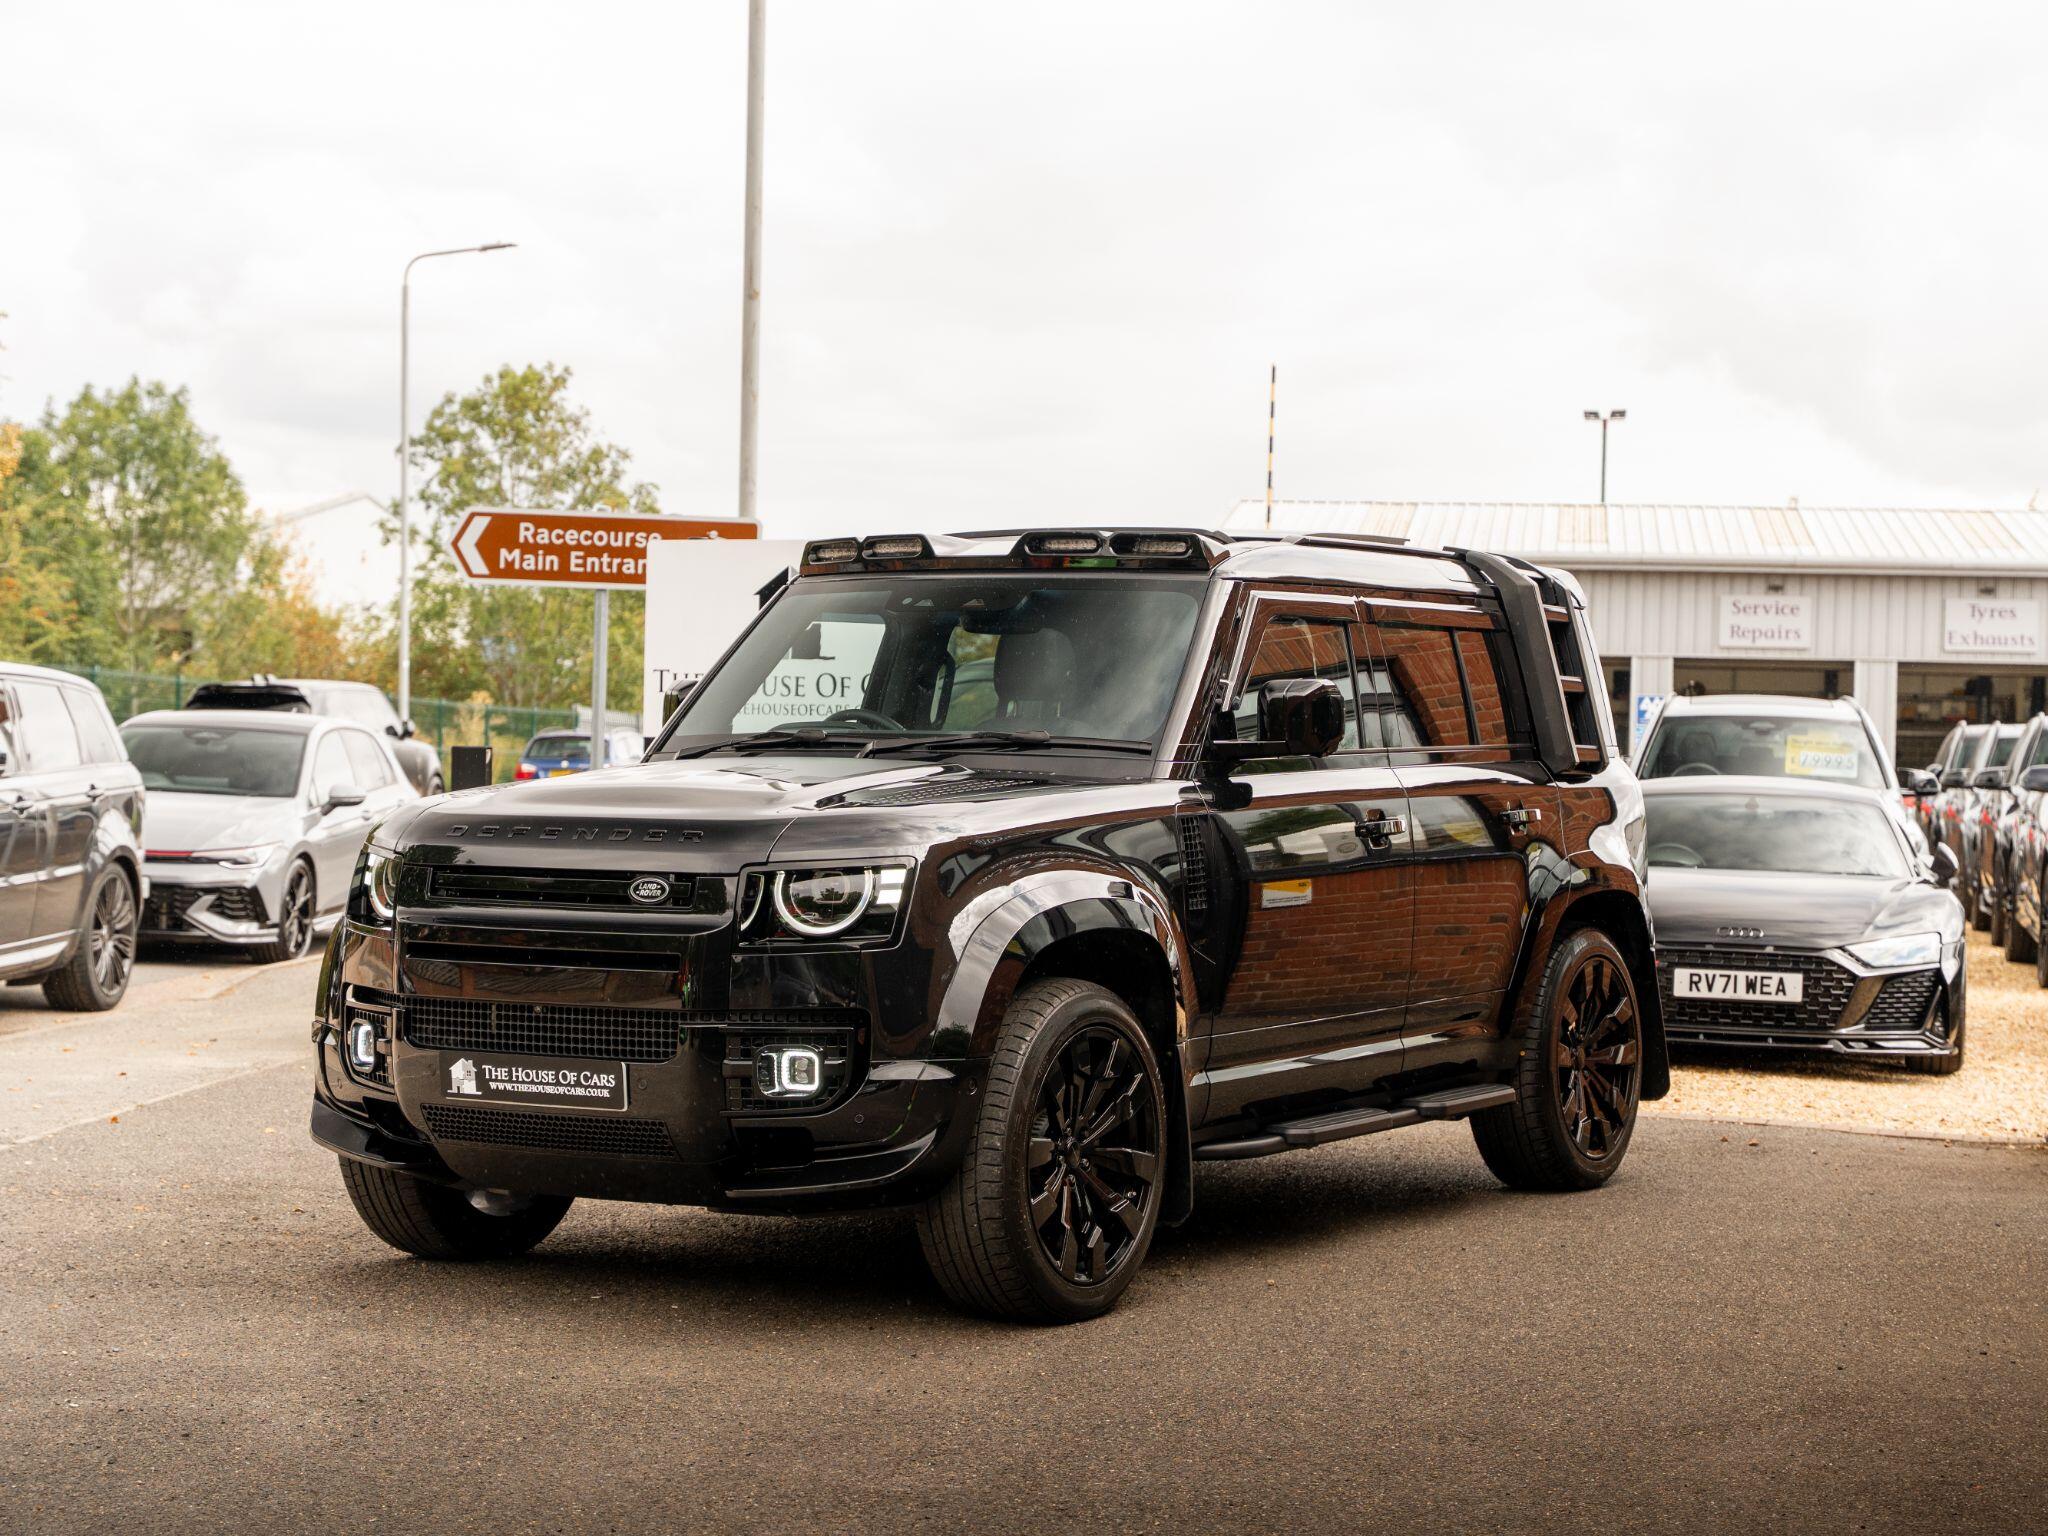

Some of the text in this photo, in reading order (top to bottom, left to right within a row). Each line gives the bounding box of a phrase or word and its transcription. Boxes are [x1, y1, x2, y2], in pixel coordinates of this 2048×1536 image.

[499, 547, 647, 575] Main Entran
[1731, 600, 1801, 617] Service
[1968, 603, 2018, 622] Tyres
[1729, 624, 1802, 644] Repairs
[1947, 629, 2036, 648] Exhausts
[815, 672, 852, 698] OF
[445, 823, 705, 844] DEFENDER
[638, 882, 658, 890] LAND
[639, 889, 662, 897] ROVER
[1688, 973, 1787, 997] RV71 WEA
[481, 1065, 616, 1088] THE HOUSE OF CARS
[488, 1081, 611, 1098] WWW.THEHOUSEOFCARS.CO.UK
